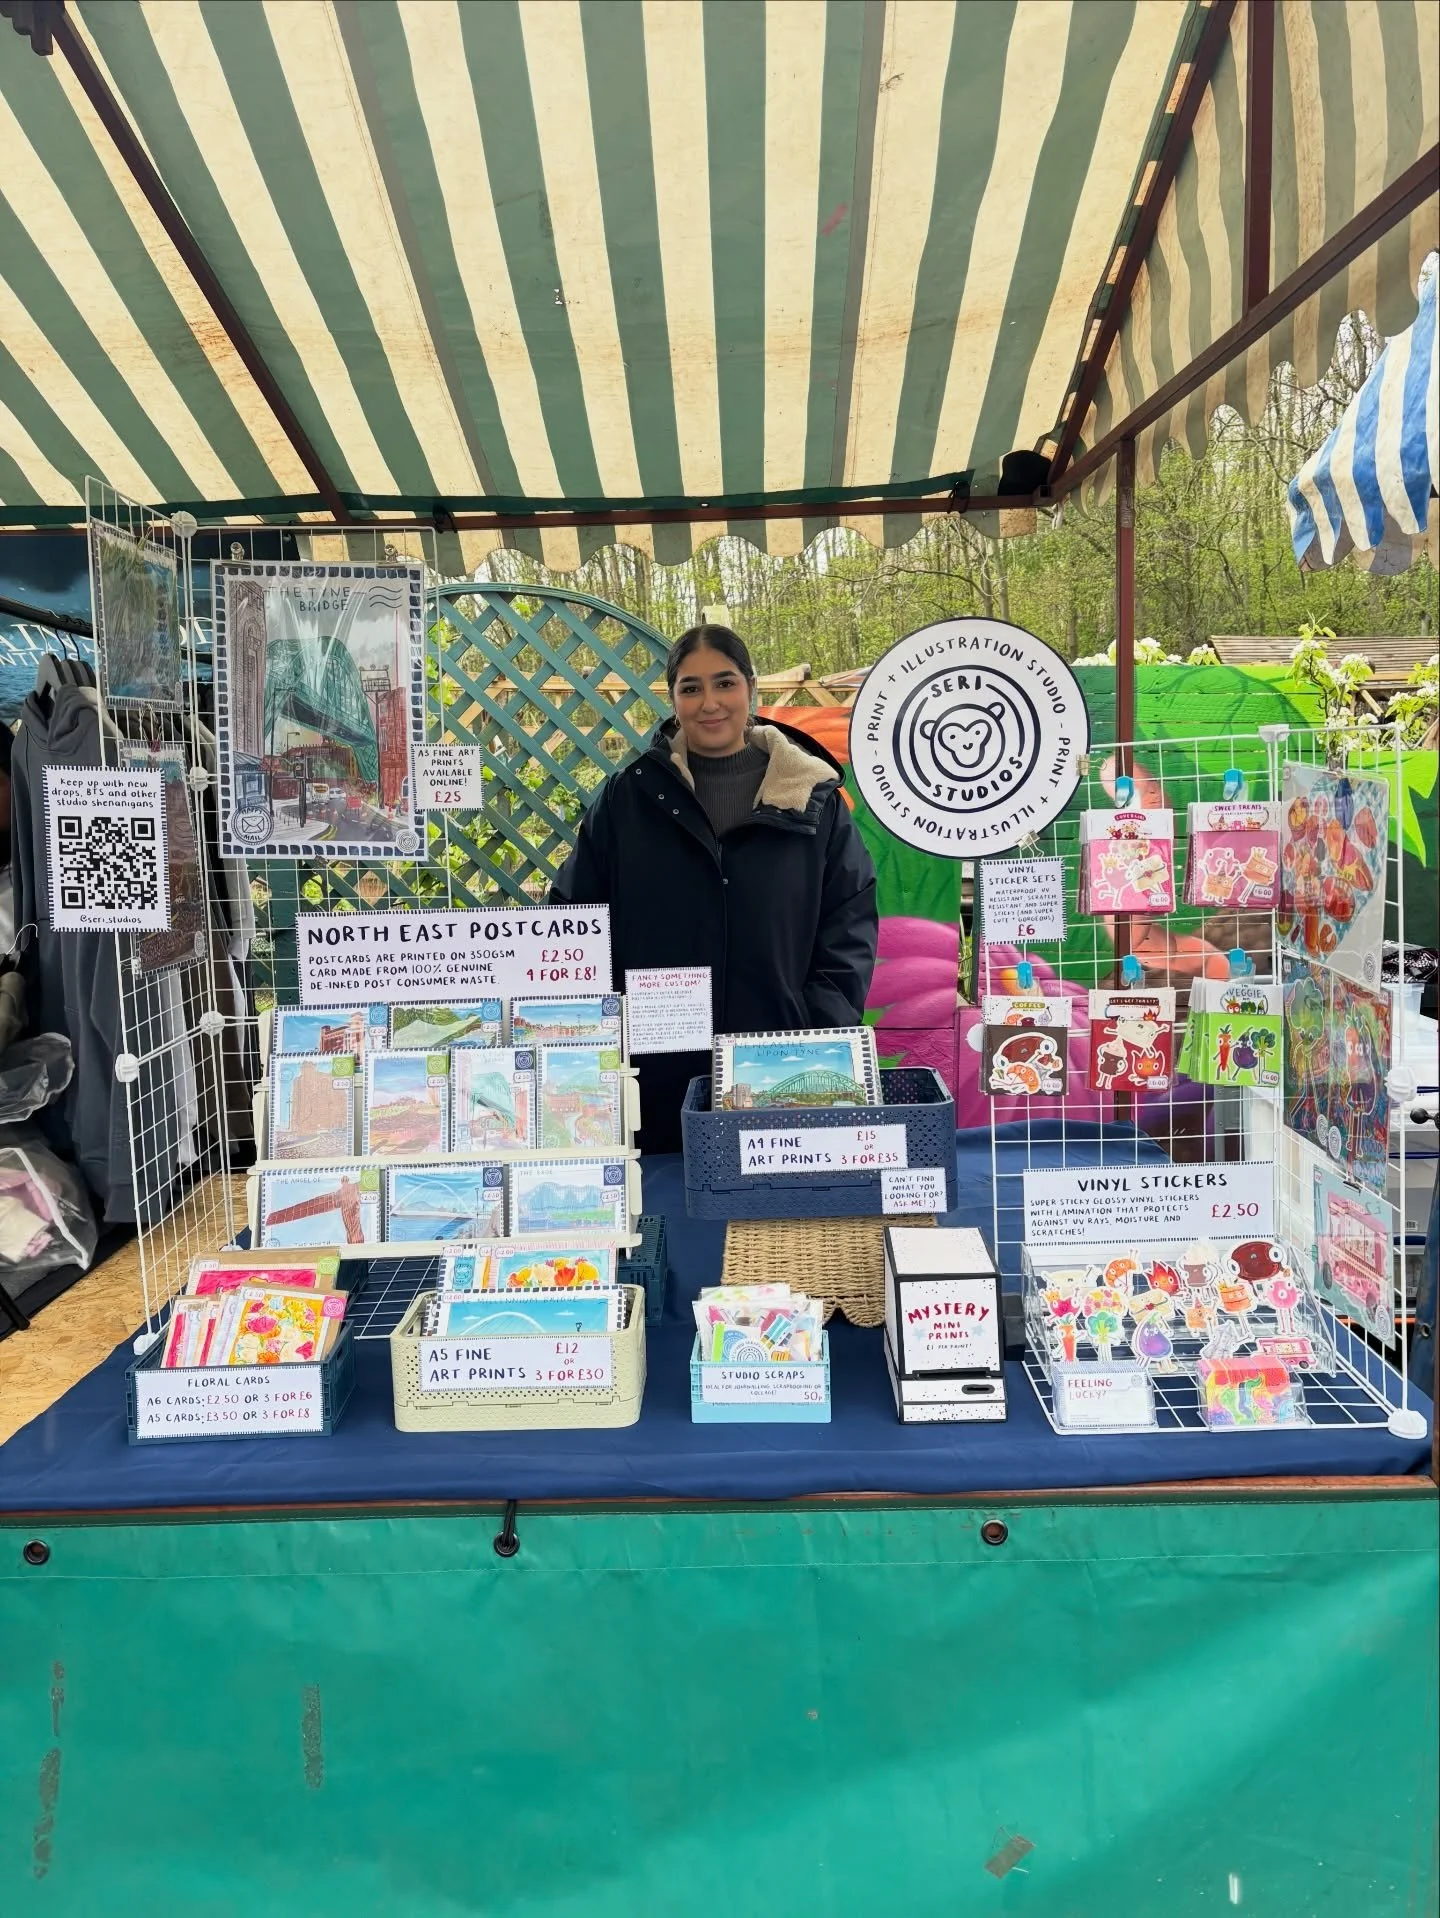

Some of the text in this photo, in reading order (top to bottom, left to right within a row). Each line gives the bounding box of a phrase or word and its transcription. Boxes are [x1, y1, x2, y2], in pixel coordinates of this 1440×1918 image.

[307, 586, 350, 598] TYNE
[299, 599, 349, 612] BRIDGE
[867, 636, 1066, 741] PRINT ILLUSTRATION STUDIO
[931, 676, 982, 698] SERI
[418, 749, 475, 757] A3 FINE ART
[423, 768, 473, 776] AVAILABLE
[103, 779, 124, 787] with
[128, 780, 148, 788] new
[429, 777, 467, 786] ONLINE!
[933, 756, 1023, 801] STUDIOS
[51, 788, 83, 797] drops,
[87, 788, 104, 796] BTS
[131, 790, 157, 798] other
[872, 737, 1071, 840] PRINT ILLUSTRATION STUDIO
[435, 791, 462, 803] £25
[57, 798, 154, 809] studio shenanigans
[989, 875, 1056, 885] STICKER SETS
[80, 914, 142, 923] @seri_studios
[308, 919, 602, 945] NORTH EAST POSTCARDS
[1018, 924, 1035, 937] £6
[309, 949, 515, 965] POSTCARDS ARE PRINTED ON 350GSM
[541, 948, 584, 963] £2.50
[310, 963, 493, 978] CARD MADE FROM 100% GENUINE
[527, 965, 597, 981] 4 FOR £8!
[660, 972, 708, 980] SOMETHING
[310, 980, 360, 990] DE-INKED
[364, 979, 391, 989] POST
[397, 976, 456, 987] CONSUMER
[639, 981, 662, 989] MORE
[1229, 988, 1262, 998] VEGGIE
[857, 1130, 876, 1141] £15
[748, 1137, 802, 1150] A4 FINE
[749, 1153, 832, 1167] ART PRINTS
[841, 1152, 898, 1164] 3 FOR £35
[1078, 1173, 1227, 1192] VINYL STICKERS
[1030, 1198, 1056, 1206] SUPER
[1060, 1198, 1090, 1206] STICKY
[1159, 1193, 1200, 1202] STICKERS
[1056, 1207, 1112, 1216] LAMINATION
[1116, 1206, 1138, 1214] THAT
[1144, 1204, 1189, 1212] PROTECTS
[1212, 1203, 1259, 1219] £2.50
[1031, 1218, 1068, 1227] AGAINST
[1115, 1215, 1159, 1223] MOISTURE
[1031, 1227, 1085, 1236] SCRATCHES!
[908, 1302, 990, 1324] MYSTERY
[928, 1331, 969, 1340] PRINTS
[556, 1342, 579, 1354] £12
[429, 1348, 492, 1362] A5 FINE
[430, 1367, 526, 1382] ART PRINTS
[535, 1368, 604, 1381] 3 FOR £30
[721, 1370, 805, 1380] STUDIO SCRAPS
[187, 1376, 270, 1387] FLORAL CARDS
[1068, 1379, 1113, 1388] FEELING
[147, 1396, 162, 1407] A6
[166, 1396, 205, 1407] CARDS:
[244, 1393, 259, 1404] OR
[264, 1394, 270, 1402] 3
[275, 1392, 297, 1402] FOR
[300, 1391, 312, 1400] £6
[804, 1391, 822, 1401] 50p
[147, 1413, 161, 1424] A5
[165, 1413, 205, 1424] CARDS:
[243, 1410, 257, 1420] OR
[262, 1410, 268, 1419] 3
[273, 1409, 295, 1419] FOR
[298, 1408, 310, 1418] £8
